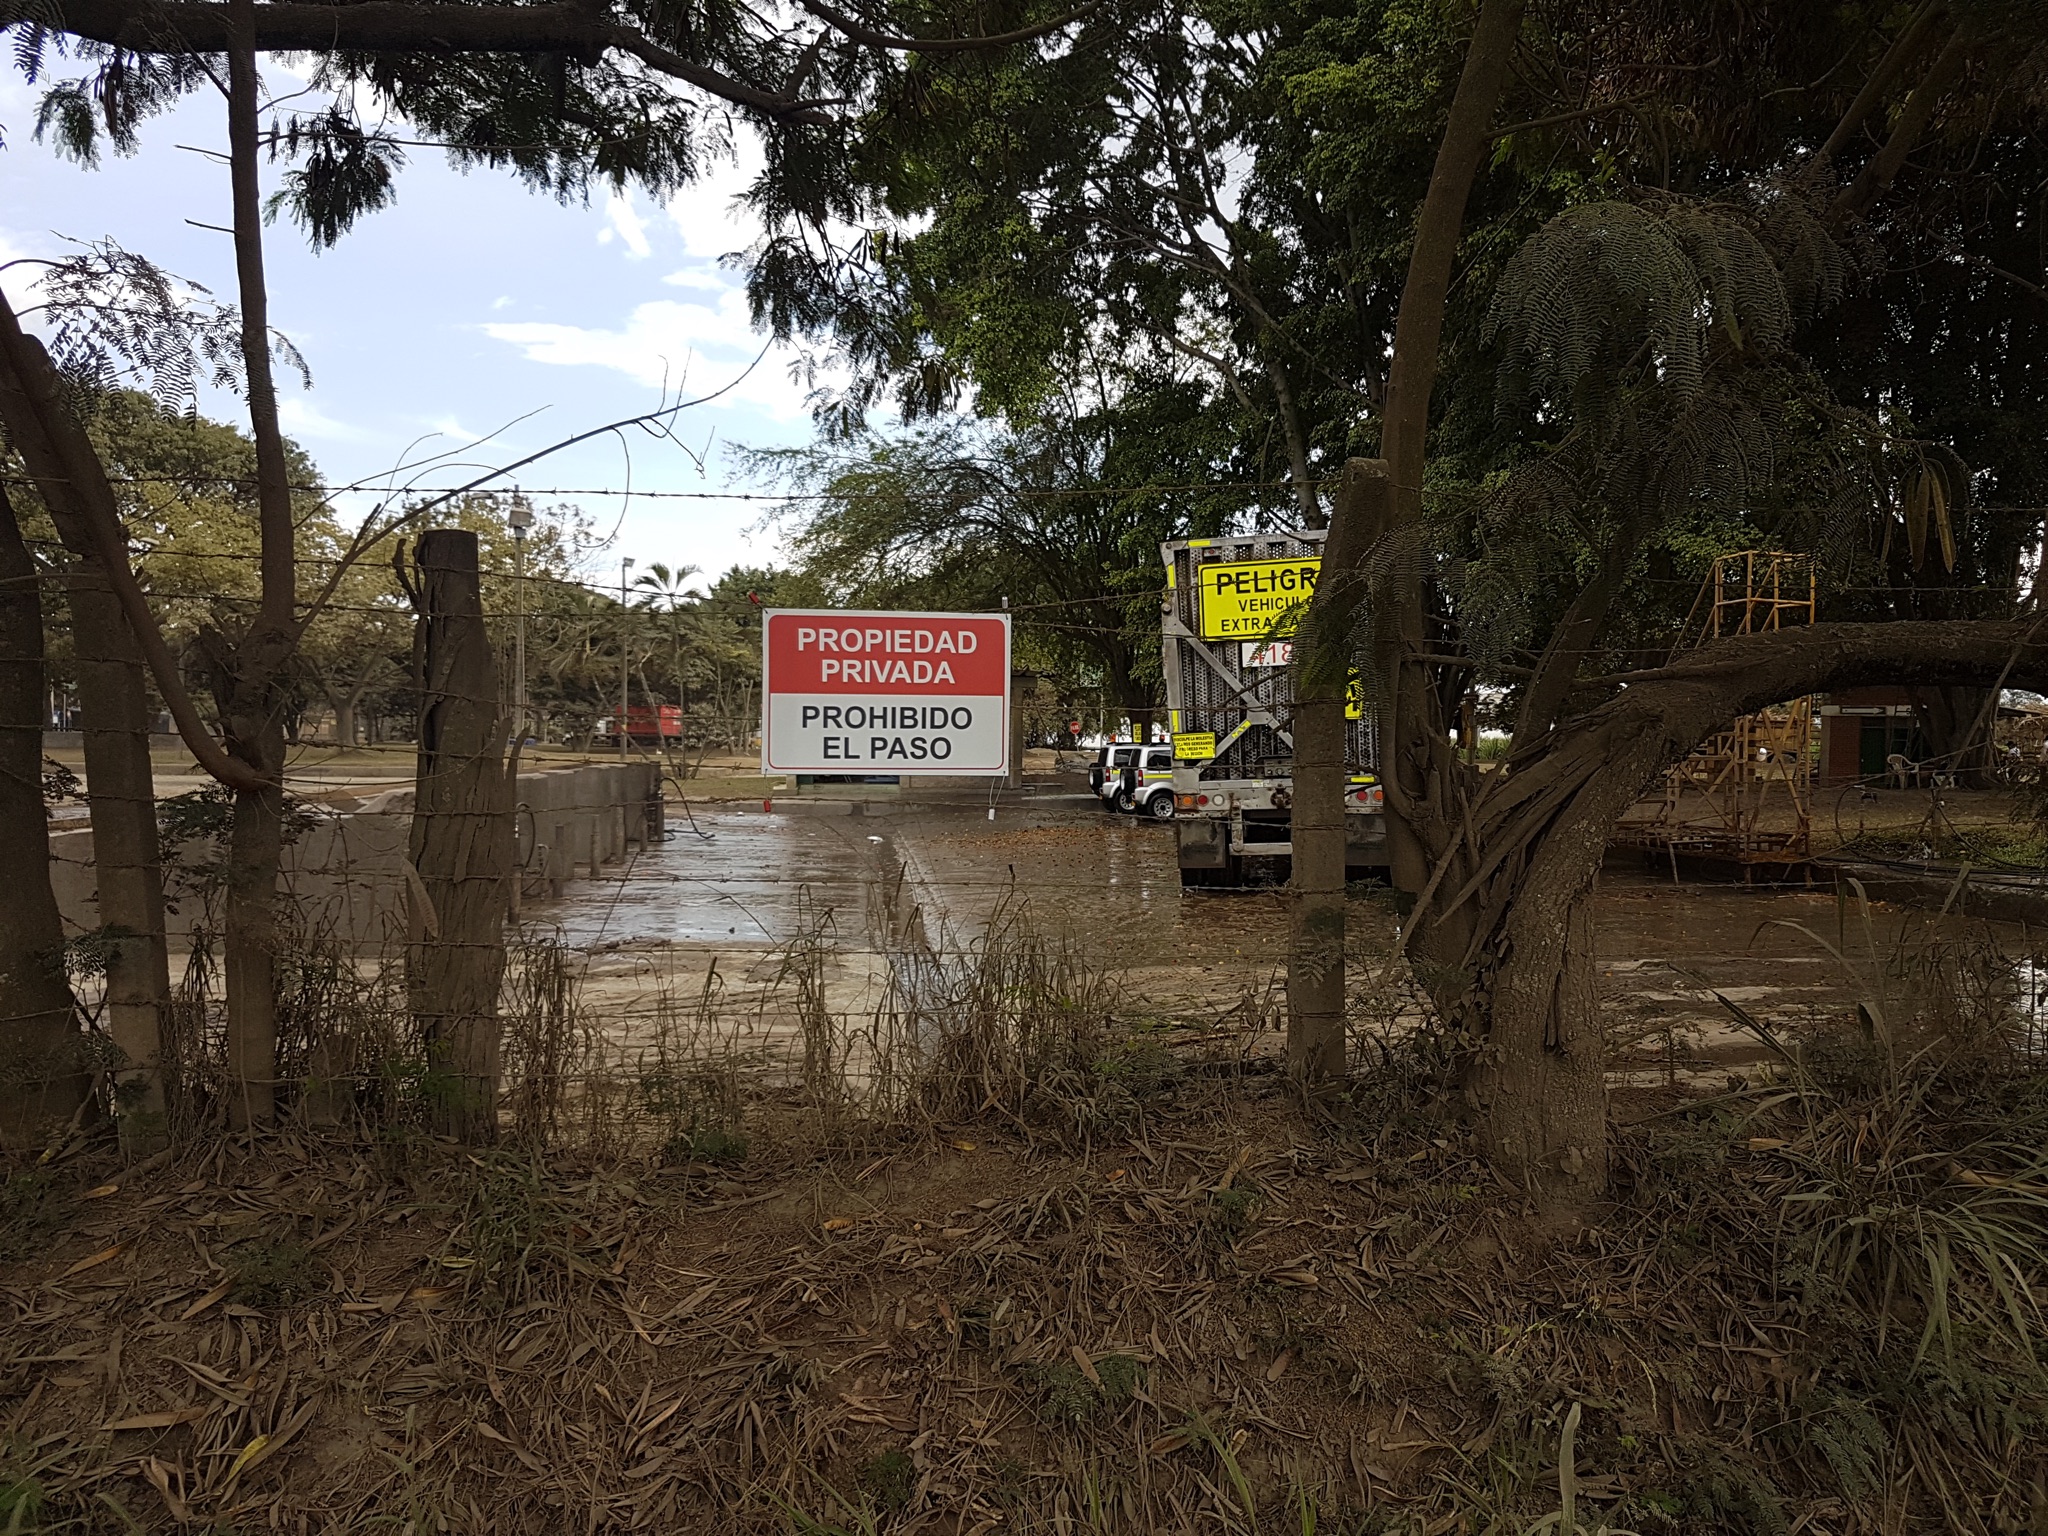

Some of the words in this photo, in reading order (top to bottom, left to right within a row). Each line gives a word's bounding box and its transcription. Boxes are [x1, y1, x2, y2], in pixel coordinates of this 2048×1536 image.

[798, 627, 978, 654] PROPIEDAD
[821, 659, 956, 684] PRIVADA
[801, 705, 973, 730] PROHIBIDO
[823, 736, 860, 760] EL
[870, 736, 952, 760] PASO
